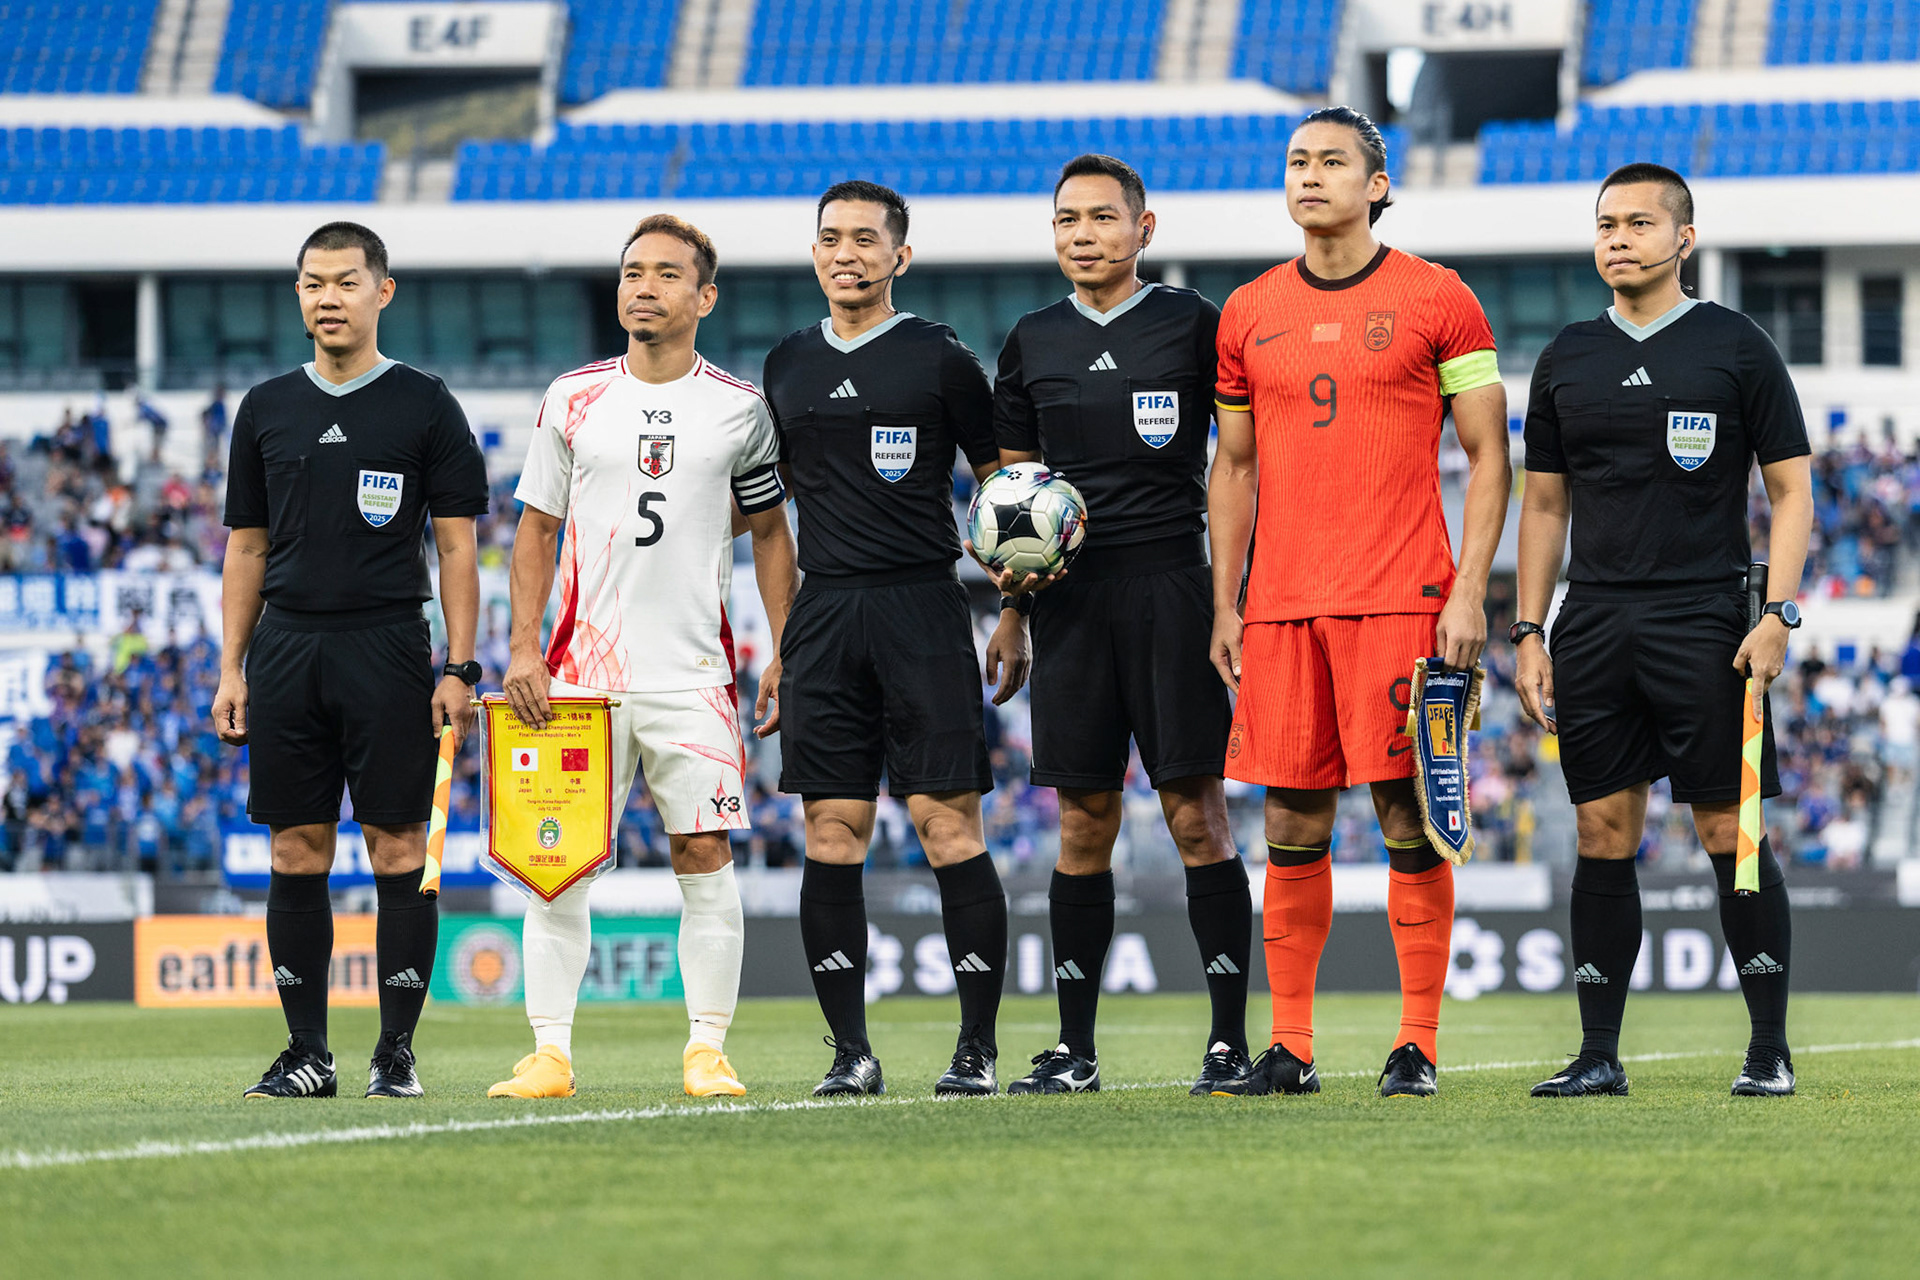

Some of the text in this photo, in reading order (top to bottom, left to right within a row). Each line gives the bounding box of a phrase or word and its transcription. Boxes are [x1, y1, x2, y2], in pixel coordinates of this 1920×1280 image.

[409, 14, 492, 51] E4F
[1137, 396, 1174, 409] FIFA
[1309, 373, 1337, 428] 9
[641, 410, 672, 424] Y-3
[1138, 417, 1175, 425] REFEREE
[1672, 416, 1711, 431] FIFA
[318, 435, 347, 444] adidas
[875, 431, 912, 444] FIFA
[875, 452, 912, 460] REFEREE
[1681, 457, 1699, 465] 2025
[647, 464, 663, 472] JFA
[363, 474, 398, 490] FIFA
[362, 493, 397, 502] ASSISTANT
[363, 500, 393, 508] REFEREE
[369, 514, 386, 522] 2025
[635, 491, 667, 547] 5
[1429, 707, 1445, 721] JFA
[710, 796, 741, 813] Y-3
[1740, 963, 1784, 976] adidas
[385, 978, 425, 989] adidas
